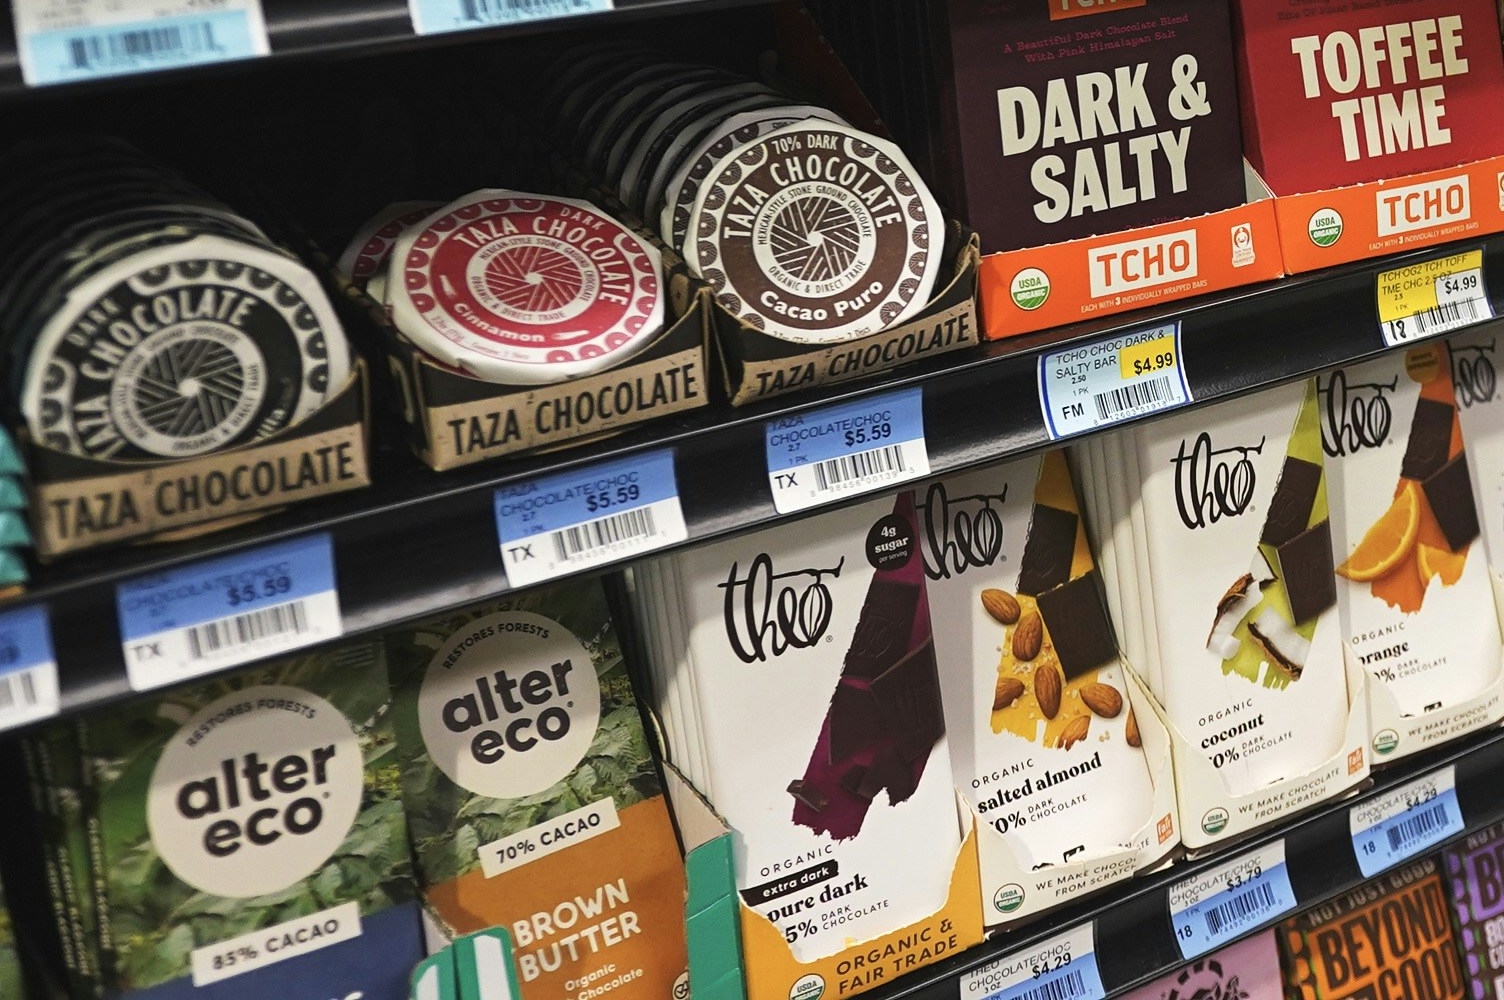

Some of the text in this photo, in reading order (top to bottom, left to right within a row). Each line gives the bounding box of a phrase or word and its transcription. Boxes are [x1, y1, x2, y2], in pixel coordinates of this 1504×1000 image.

[1291, 14, 1469, 99] TOFFEE
[997, 53, 1212, 157] DARK &
[1331, 85, 1452, 162] TIME
[772, 134, 838, 154] 70% DARK
[1029, 126, 1191, 224] SALTY
[560, 206, 606, 230] DARK
[454, 216, 630, 307] TAZA CHOCOLATE
[760, 279, 884, 322] Cacao Puro
[1444, 276, 1478, 295] $4.99
[453, 302, 546, 344] Cinnamon
[756, 319, 971, 397] TAZA CHOCOLATE
[1055, 330, 1165, 366] TCHO CHOC DARK &
[1056, 355, 1117, 380] SALTY BAR
[1133, 352, 1173, 376] $4.99
[447, 364, 699, 457] TAZA CHOCOLATE
[1062, 404, 1085, 420] FM
[54, 441, 356, 542] TAZA CHOCOLATE
[774, 472, 800, 490] TX
[507, 547, 536, 563] TX
[874, 536, 909, 554] sugar
[227, 575, 294, 607] $5.59
[132, 640, 164, 662] TX
[442, 620, 551, 669] RESTORES FORESTS
[441, 657, 574, 735] alter
[186, 699, 319, 748] RESTORES FORESTS
[469, 703, 570, 766] eco
[176, 741, 337, 821] alter
[1238, 768, 1340, 815] WE MAKE CHOCOLATE
[1255, 786, 1327, 820] FROM SCRATCH
[202, 801, 324, 858] eco
[762, 867, 830, 898] extra dark
[212, 918, 342, 973] 85% CACAO
[836, 918, 953, 975] ORGANIC &
[1177, 925, 1193, 941] 18
[577, 967, 644, 1000] Chocolate
